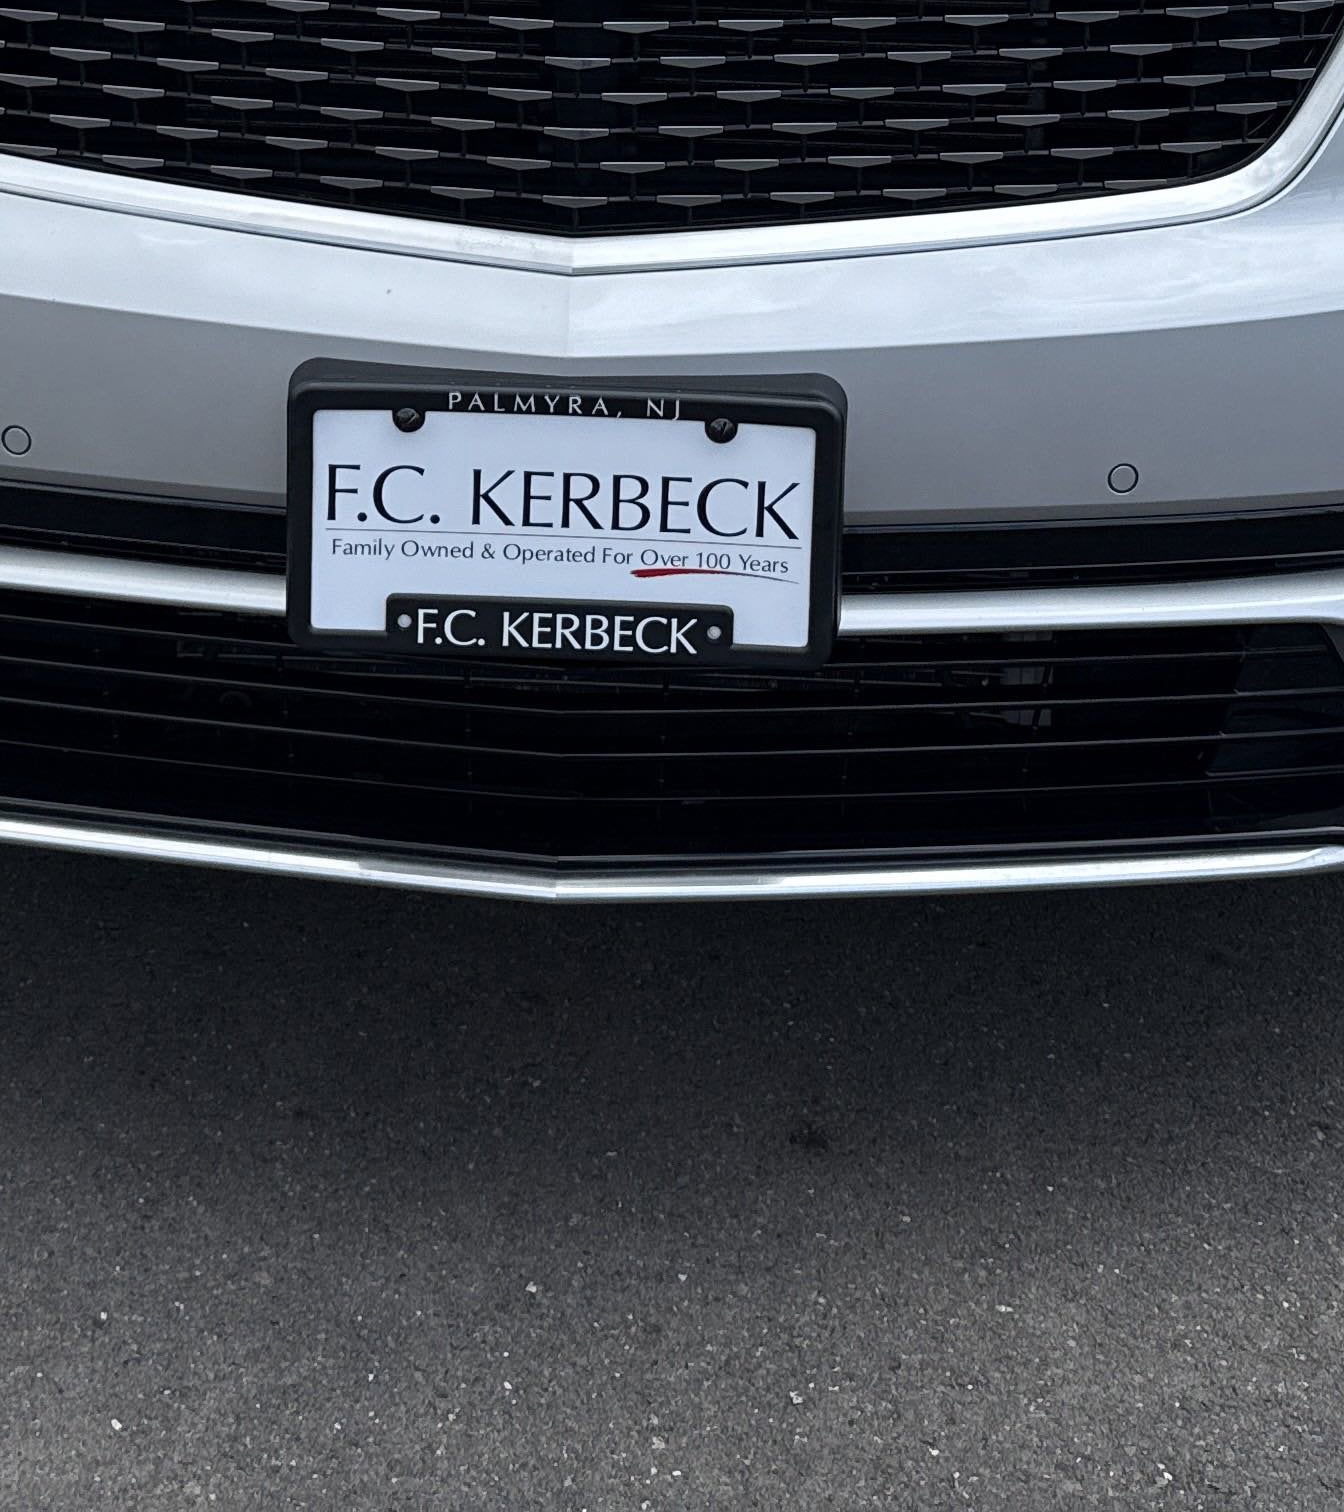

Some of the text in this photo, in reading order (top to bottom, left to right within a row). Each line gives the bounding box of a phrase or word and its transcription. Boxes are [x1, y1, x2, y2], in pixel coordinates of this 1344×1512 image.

[448, 392, 681, 421] PALMYRA, NJ
[327, 464, 800, 540] F.C. KERBECK
[332, 538, 789, 574] Family Owned & Operated For Over 100 Years
[417, 608, 698, 655] F.C. KERBECK
